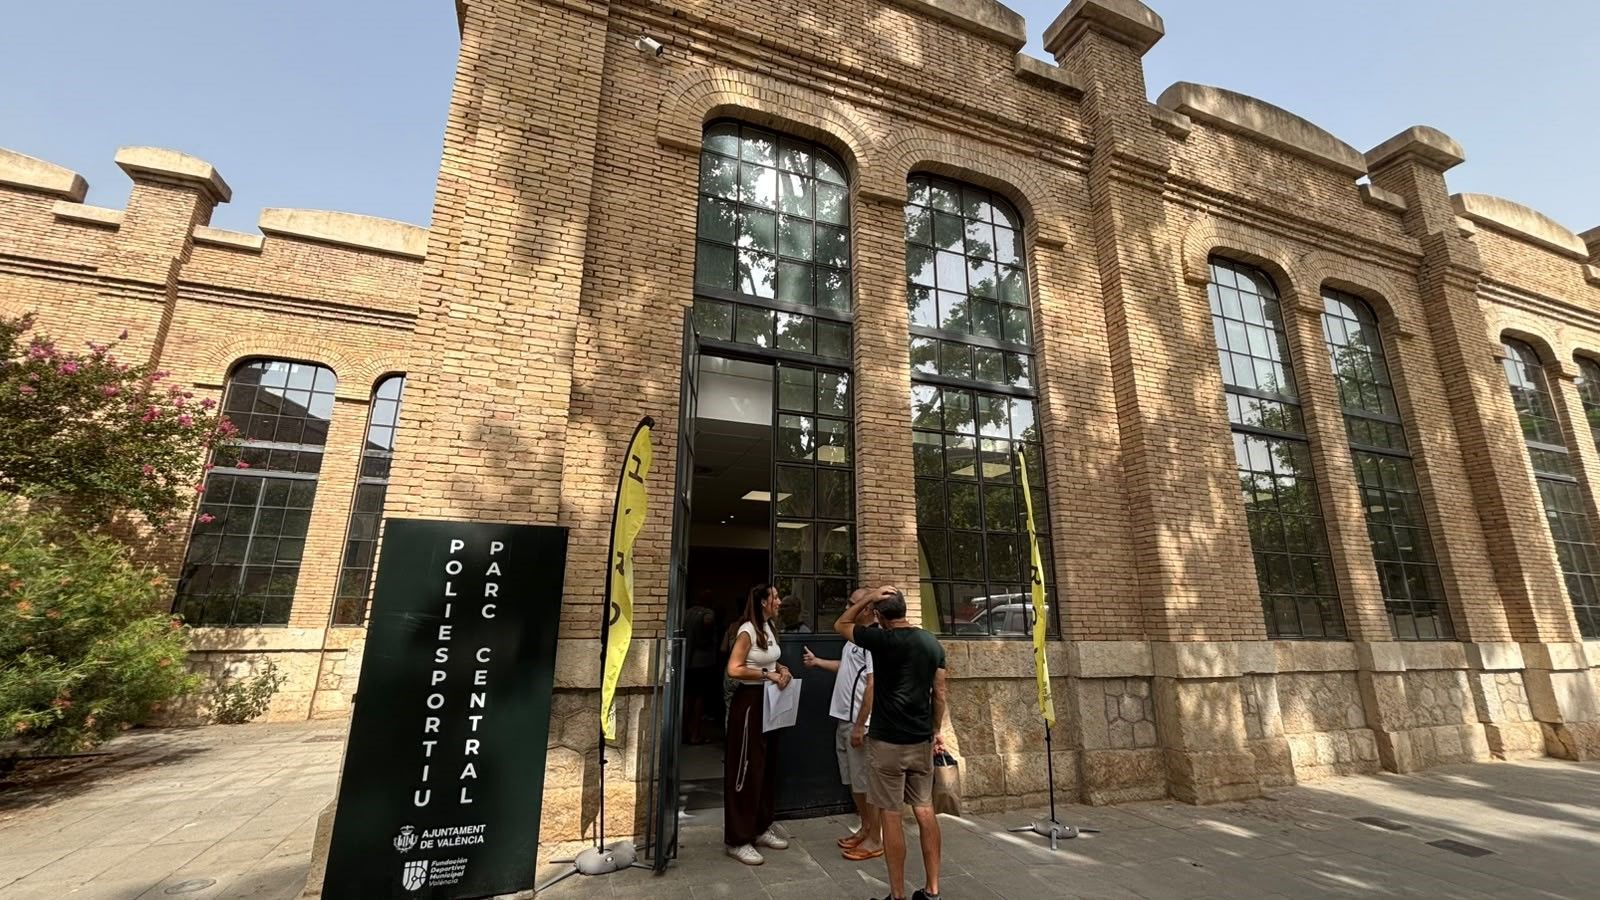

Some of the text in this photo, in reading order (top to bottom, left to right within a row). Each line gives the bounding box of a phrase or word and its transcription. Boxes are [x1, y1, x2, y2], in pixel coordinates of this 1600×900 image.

[414, 538, 465, 807] POLIESPORTIU
[459, 540, 505, 804] PARC CENTRAL
[421, 824, 487, 839] AJUNTAMENT
[420, 834, 485, 849] DE VALÈNCIA
[429, 870, 464, 880] Municipal
[430, 864, 466, 874] Deportiva
